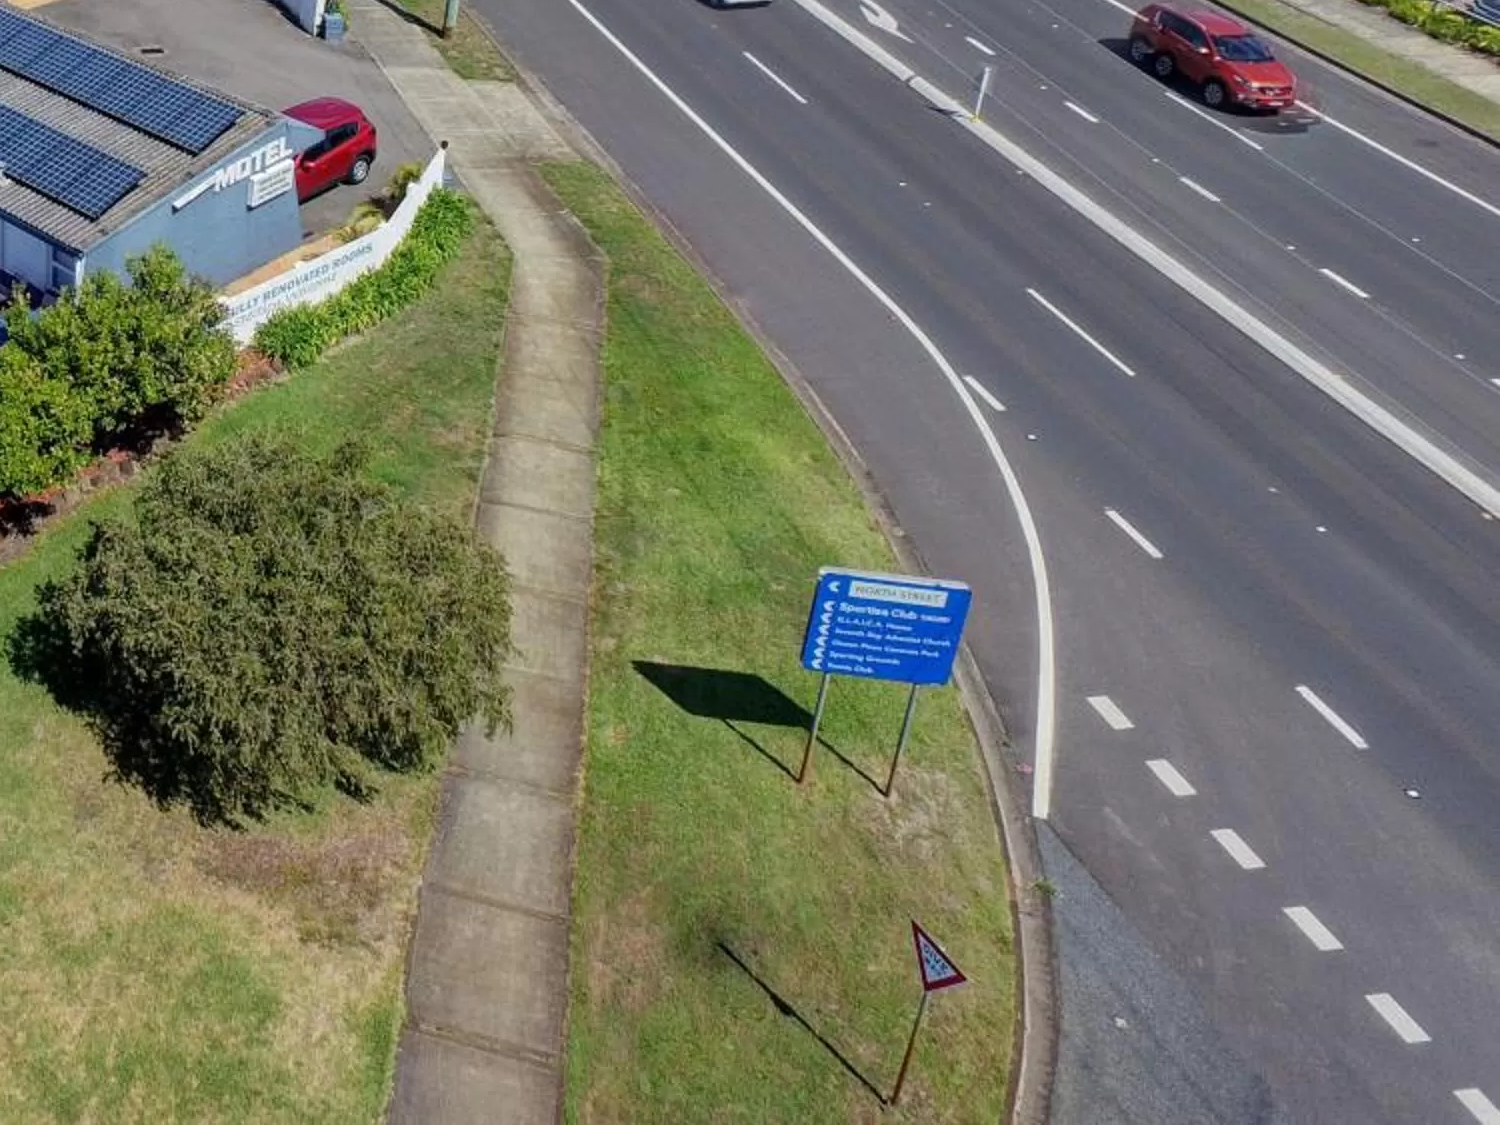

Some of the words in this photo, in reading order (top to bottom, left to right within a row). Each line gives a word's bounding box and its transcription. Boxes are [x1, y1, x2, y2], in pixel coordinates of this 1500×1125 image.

[215, 137, 293, 191] MOTEL
[263, 264, 329, 299] RENOVATED
[331, 242, 373, 268] ROOMS
[902, 591, 942, 603] STREET
[891, 608, 918, 620] Club
[923, 943, 949, 972] GIVE
